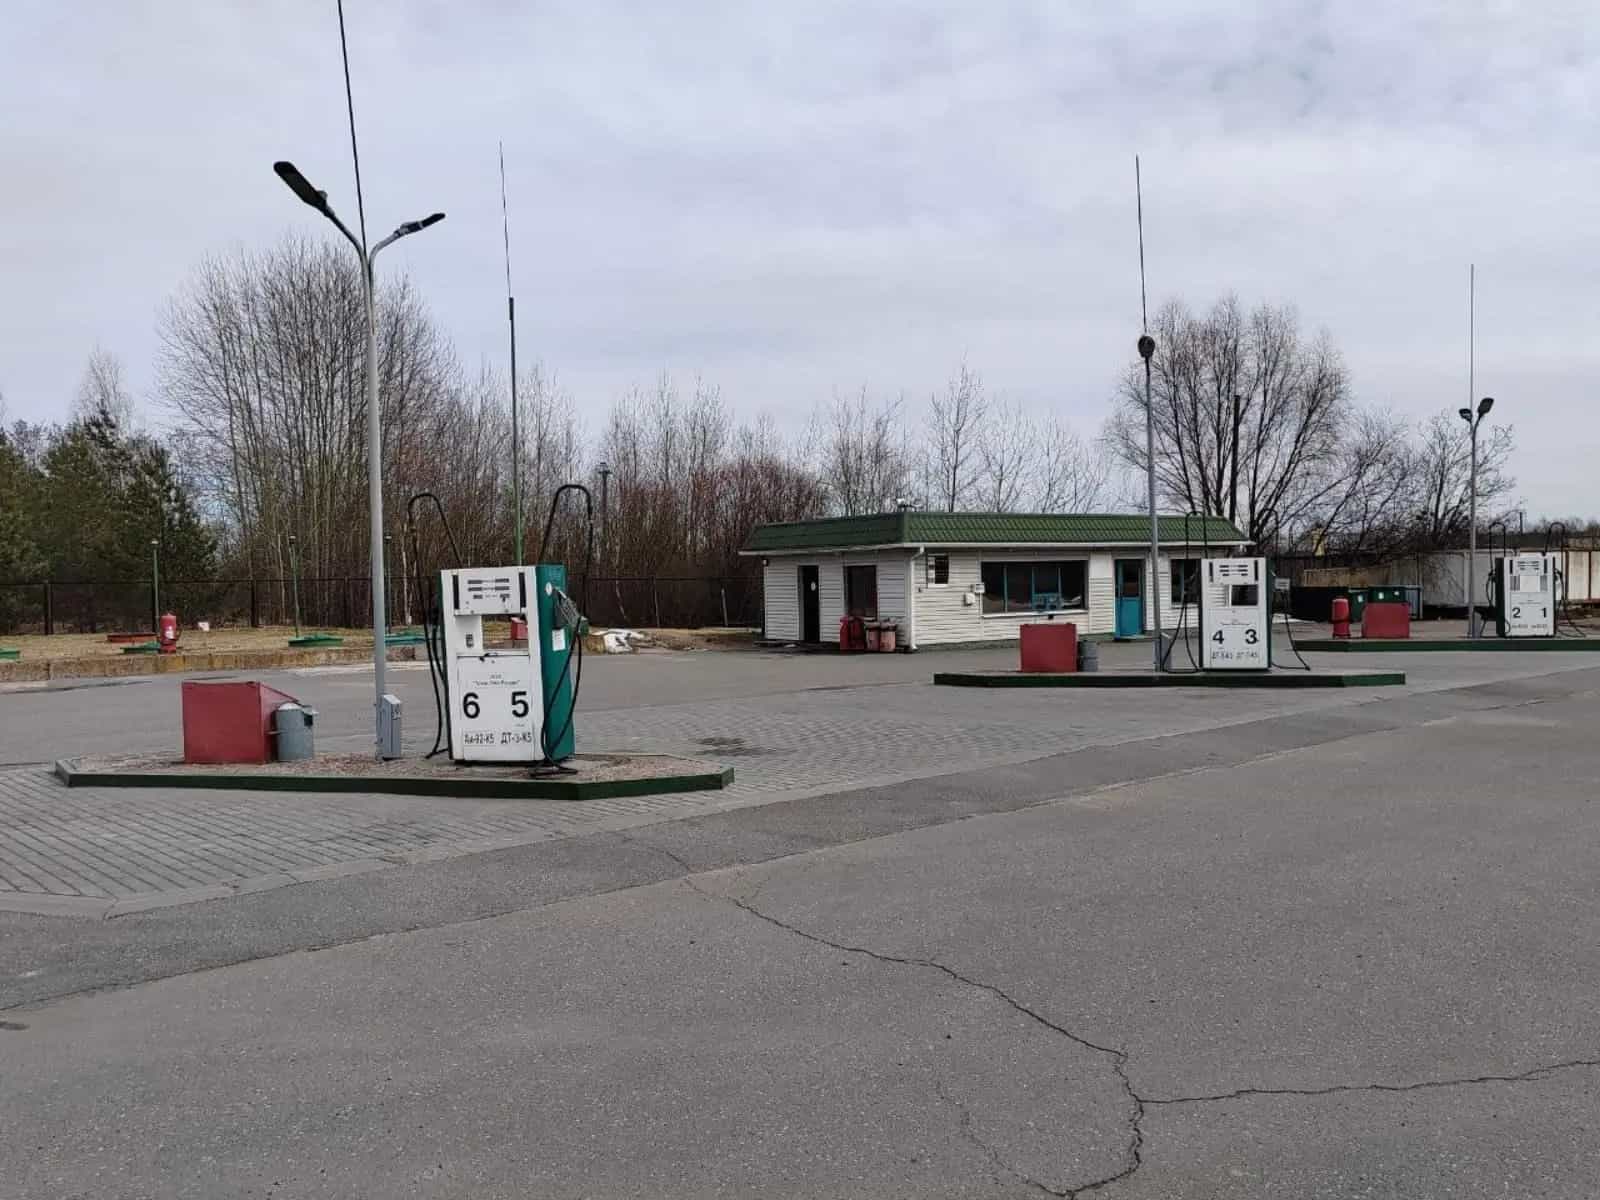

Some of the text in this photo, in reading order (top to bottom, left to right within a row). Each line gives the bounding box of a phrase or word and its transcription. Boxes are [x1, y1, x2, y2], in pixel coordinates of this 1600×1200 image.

[1512, 607, 1522, 619] 2
[1541, 607, 1547, 618] 1
[1212, 629, 1224, 645] 4
[1245, 628, 1258, 645] 3
[463, 692, 480, 719] 6
[511, 690, 529, 718] 5
